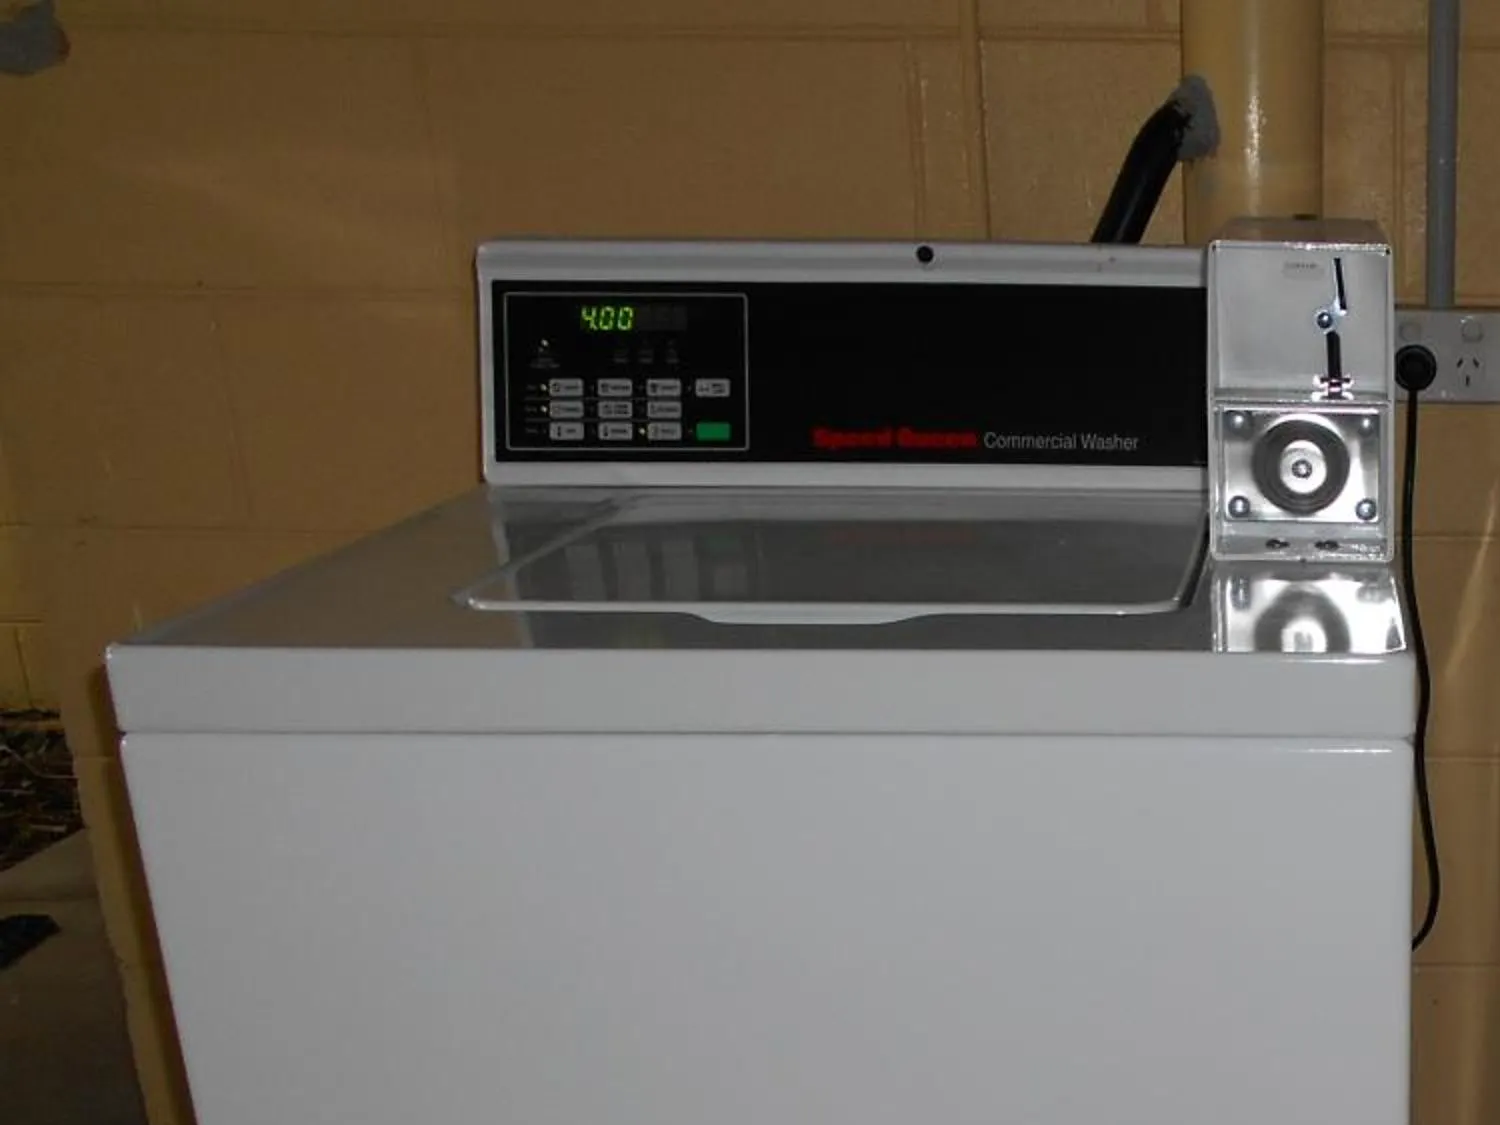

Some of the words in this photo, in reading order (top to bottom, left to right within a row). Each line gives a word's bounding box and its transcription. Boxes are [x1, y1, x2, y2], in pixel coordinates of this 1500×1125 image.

[581, 305, 634, 331] 4.00
[983, 431, 1076, 449] Commercial
[1080, 432, 1139, 450] Washer
